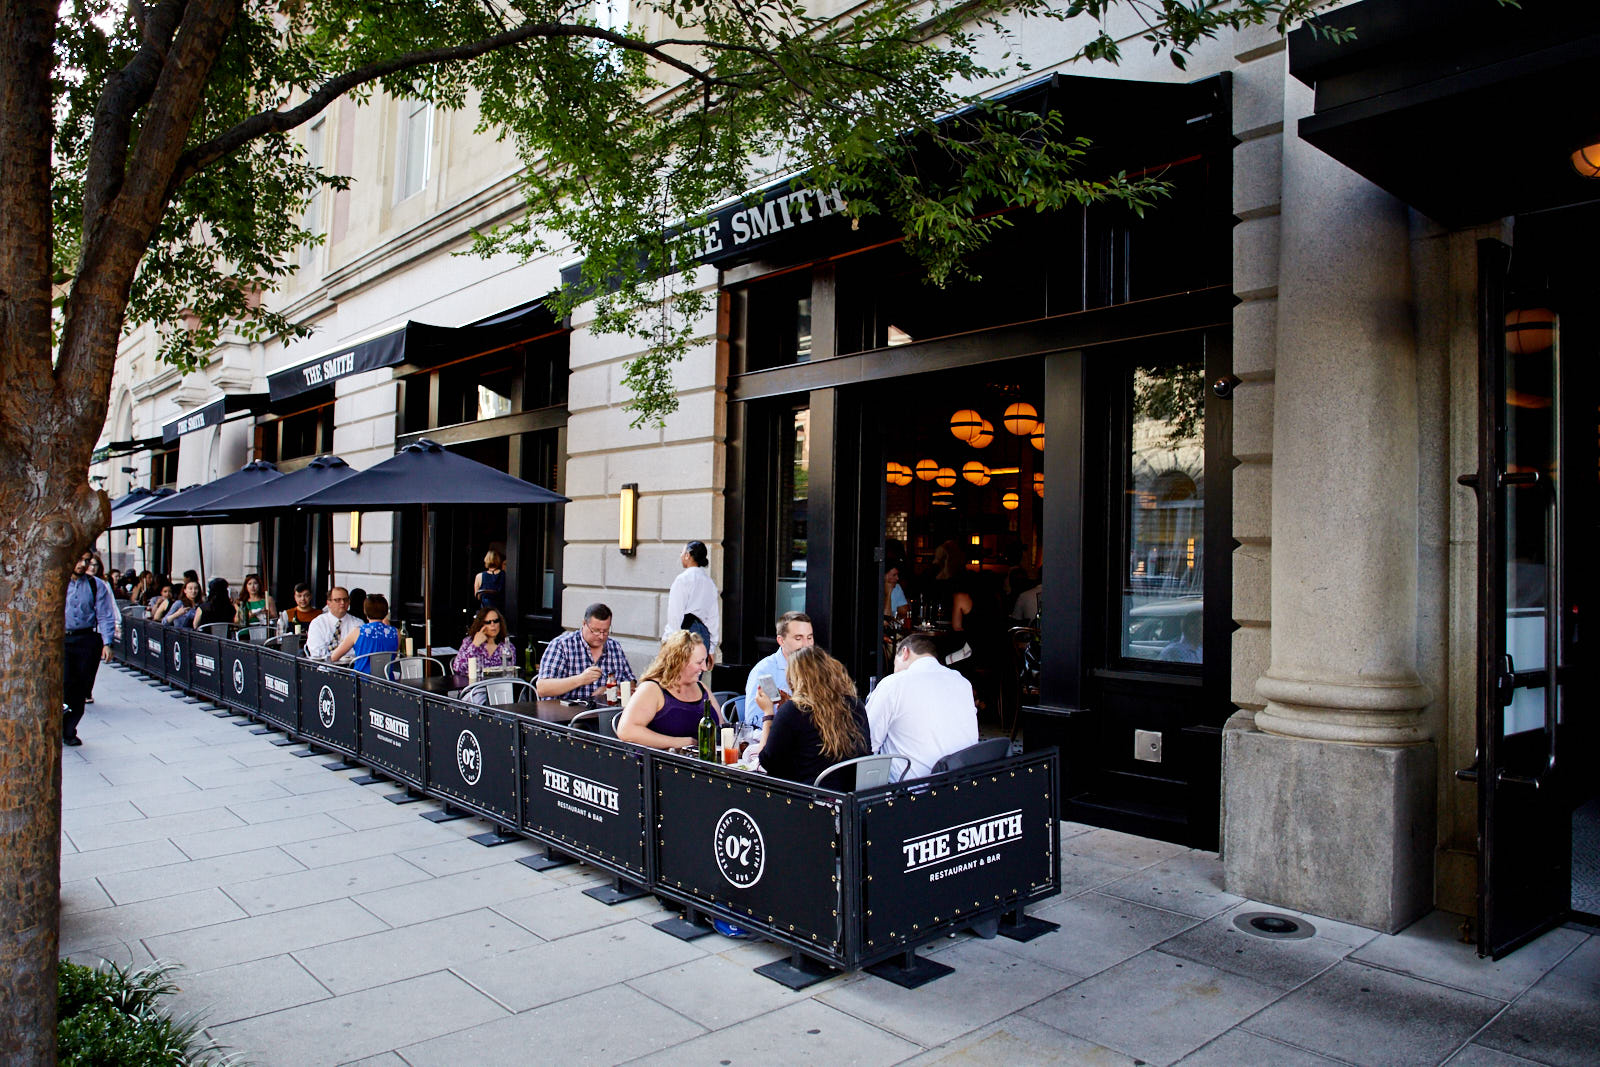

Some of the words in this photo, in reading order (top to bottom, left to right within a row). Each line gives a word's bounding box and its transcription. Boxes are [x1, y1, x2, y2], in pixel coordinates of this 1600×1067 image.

[731, 180, 847, 246] SMITH
[302, 363, 323, 386] THE
[323, 352, 355, 380] SMITH
[322, 699, 331, 716] 07
[369, 710, 384, 729] THE
[385, 716, 410, 738] SMITH
[462, 748, 476, 770] 07
[542, 769, 570, 794] THE
[572, 778, 620, 812] SMITH
[557, 800, 587, 817] RESTAURANT
[592, 813, 603, 823] BAR
[725, 835, 752, 867] 07
[902, 834, 951, 868] THE
[957, 814, 1023, 852] SMITH
[929, 860, 978, 882] RESTAURANT
[979, 858, 985, 867] &
[986, 853, 1001, 864] BAR
